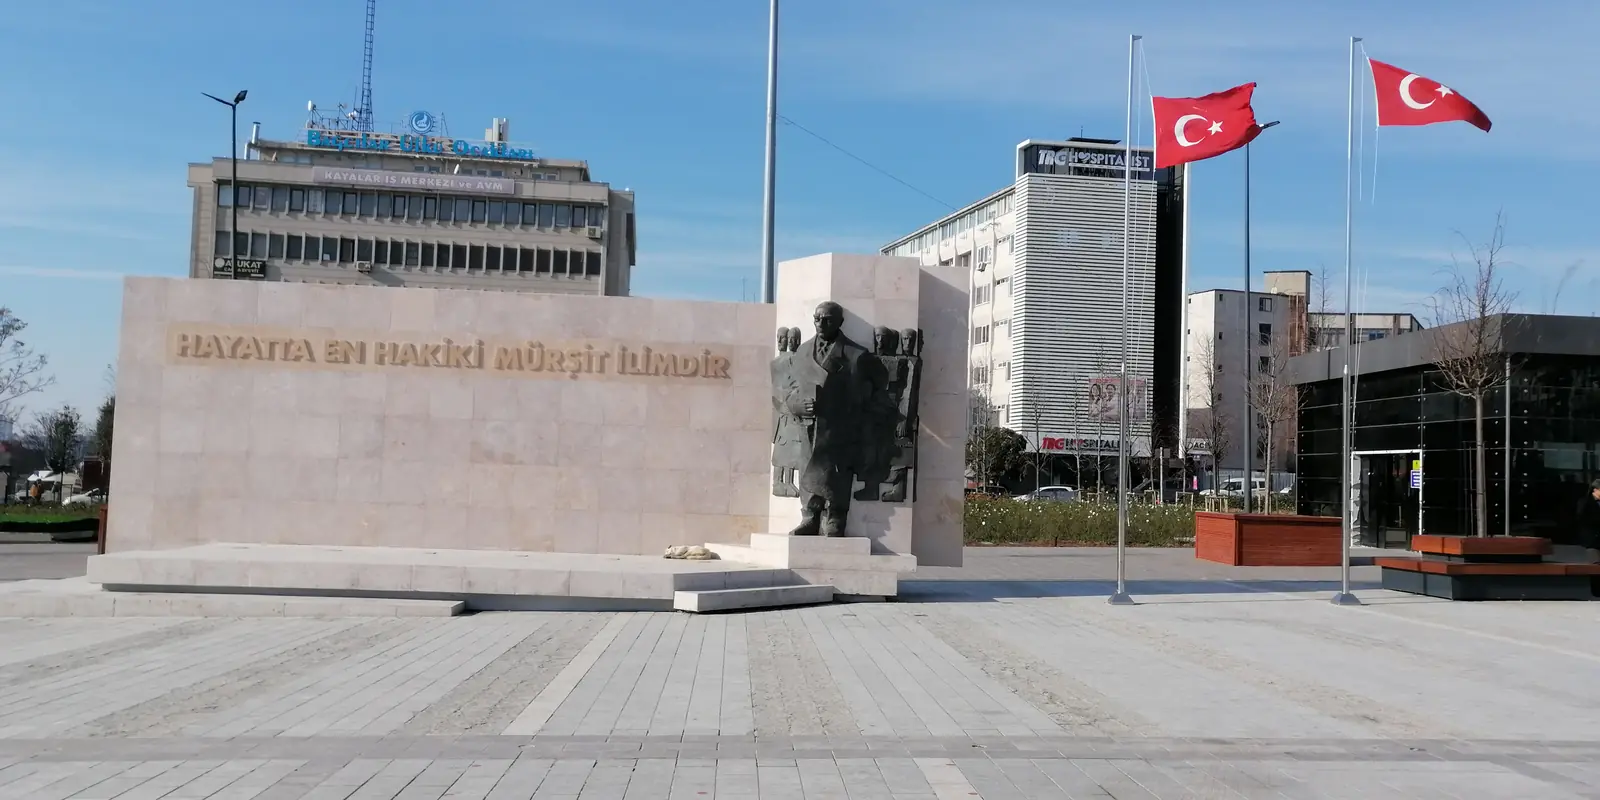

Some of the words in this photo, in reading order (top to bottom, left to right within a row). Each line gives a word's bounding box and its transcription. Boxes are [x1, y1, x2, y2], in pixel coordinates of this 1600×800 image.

[324, 170, 381, 183] KAYALAR
[458, 182, 473, 190] ve
[476, 182, 504, 192] AVM
[225, 260, 262, 268] AUKAT
[177, 333, 317, 363] HAYATTA
[324, 340, 368, 365] EN
[374, 337, 485, 369] HAKİKİ
[494, 340, 611, 381] MÜRŞİT
[616, 344, 732, 380] İLİMDİR
